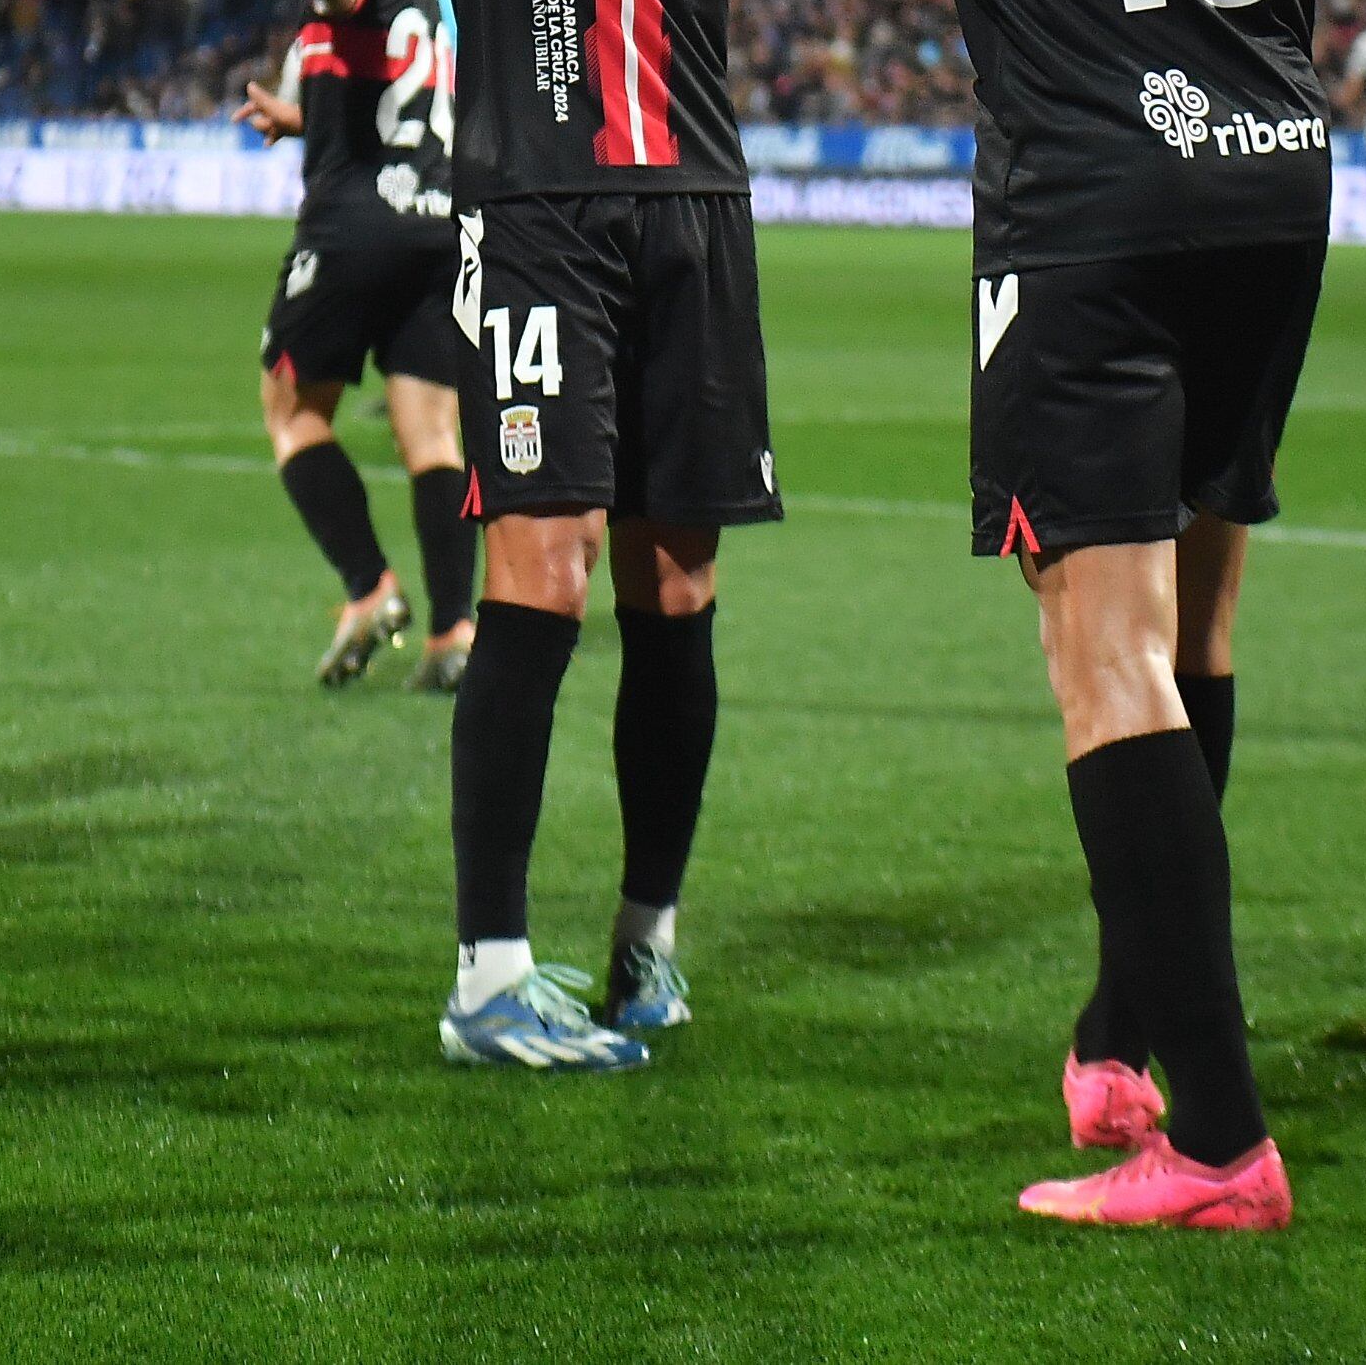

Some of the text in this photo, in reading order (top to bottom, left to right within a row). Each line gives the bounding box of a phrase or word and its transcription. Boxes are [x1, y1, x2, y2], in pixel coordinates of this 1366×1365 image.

[548, 16, 562, 36] LA
[531, 30, 551, 92] JUBILAR
[550, 38, 566, 82] CRUZ
[553, 83, 569, 123] 2024
[1212, 111, 1326, 157] ribera
[483, 305, 563, 400] 14
